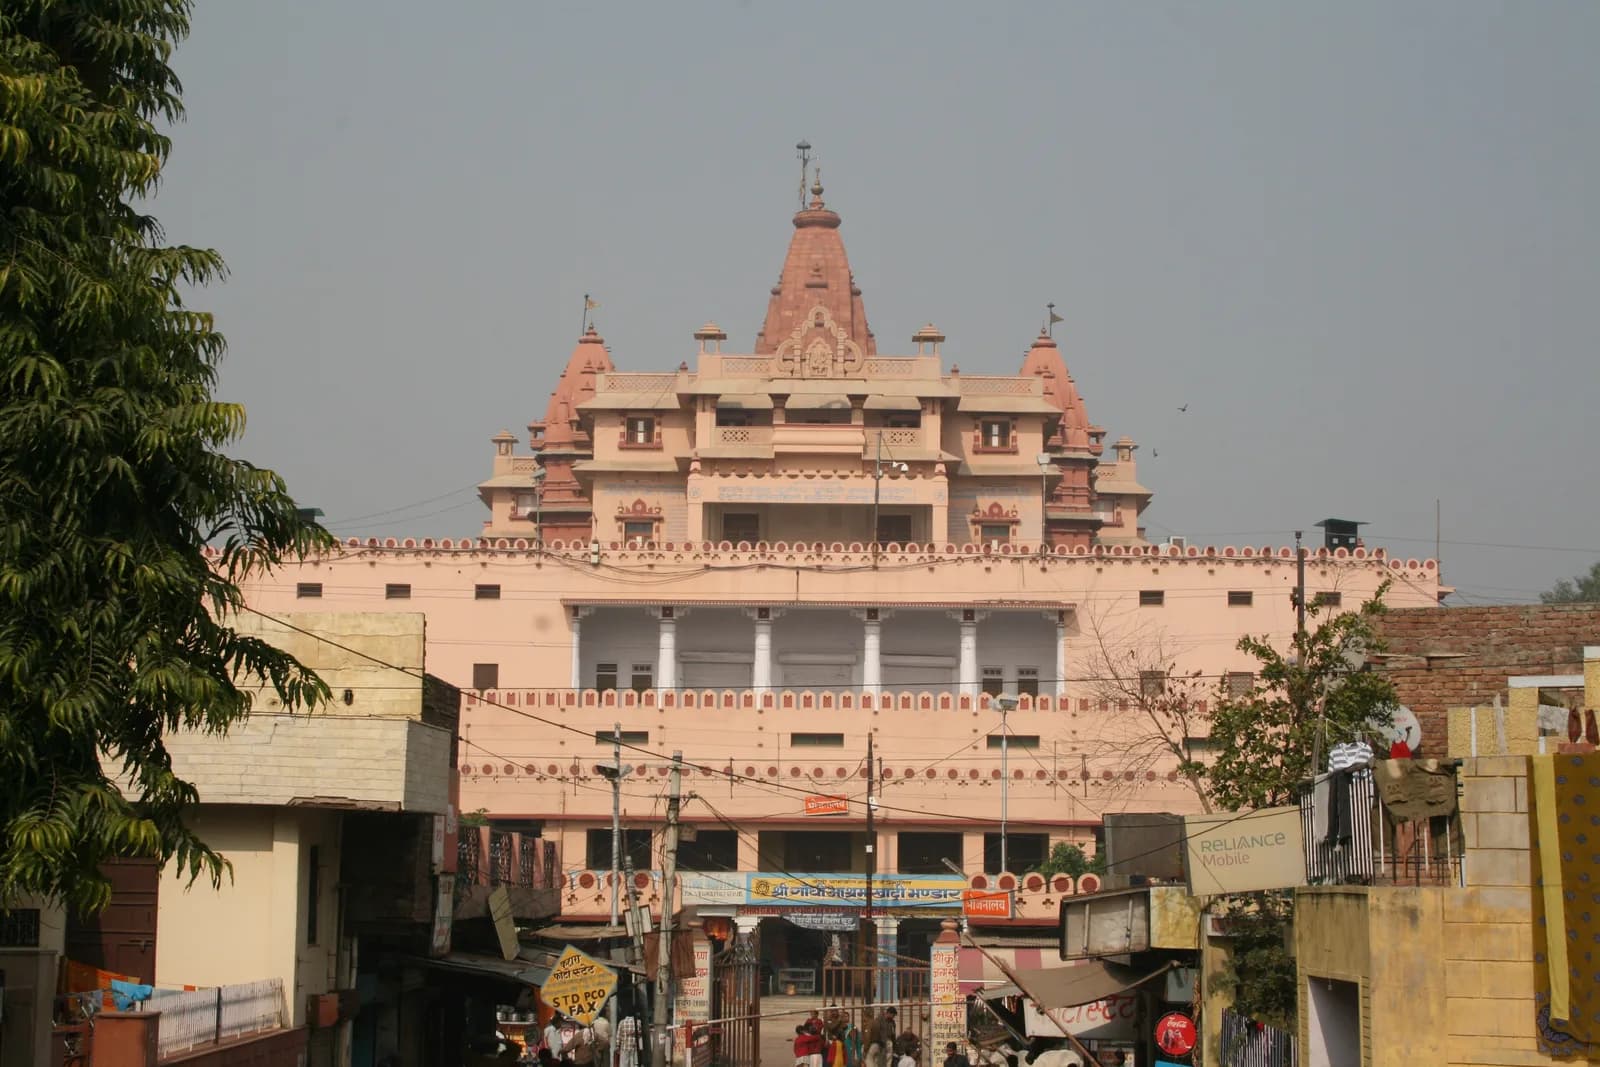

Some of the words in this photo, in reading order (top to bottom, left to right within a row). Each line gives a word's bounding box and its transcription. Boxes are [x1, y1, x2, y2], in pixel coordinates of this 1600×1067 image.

[1202, 852, 1250, 866] Mobile
[772, 883, 788, 897] श्री
[552, 993, 580, 1007] STD
[584, 989, 606, 1001] PCO
[569, 1001, 596, 1016] FAX
